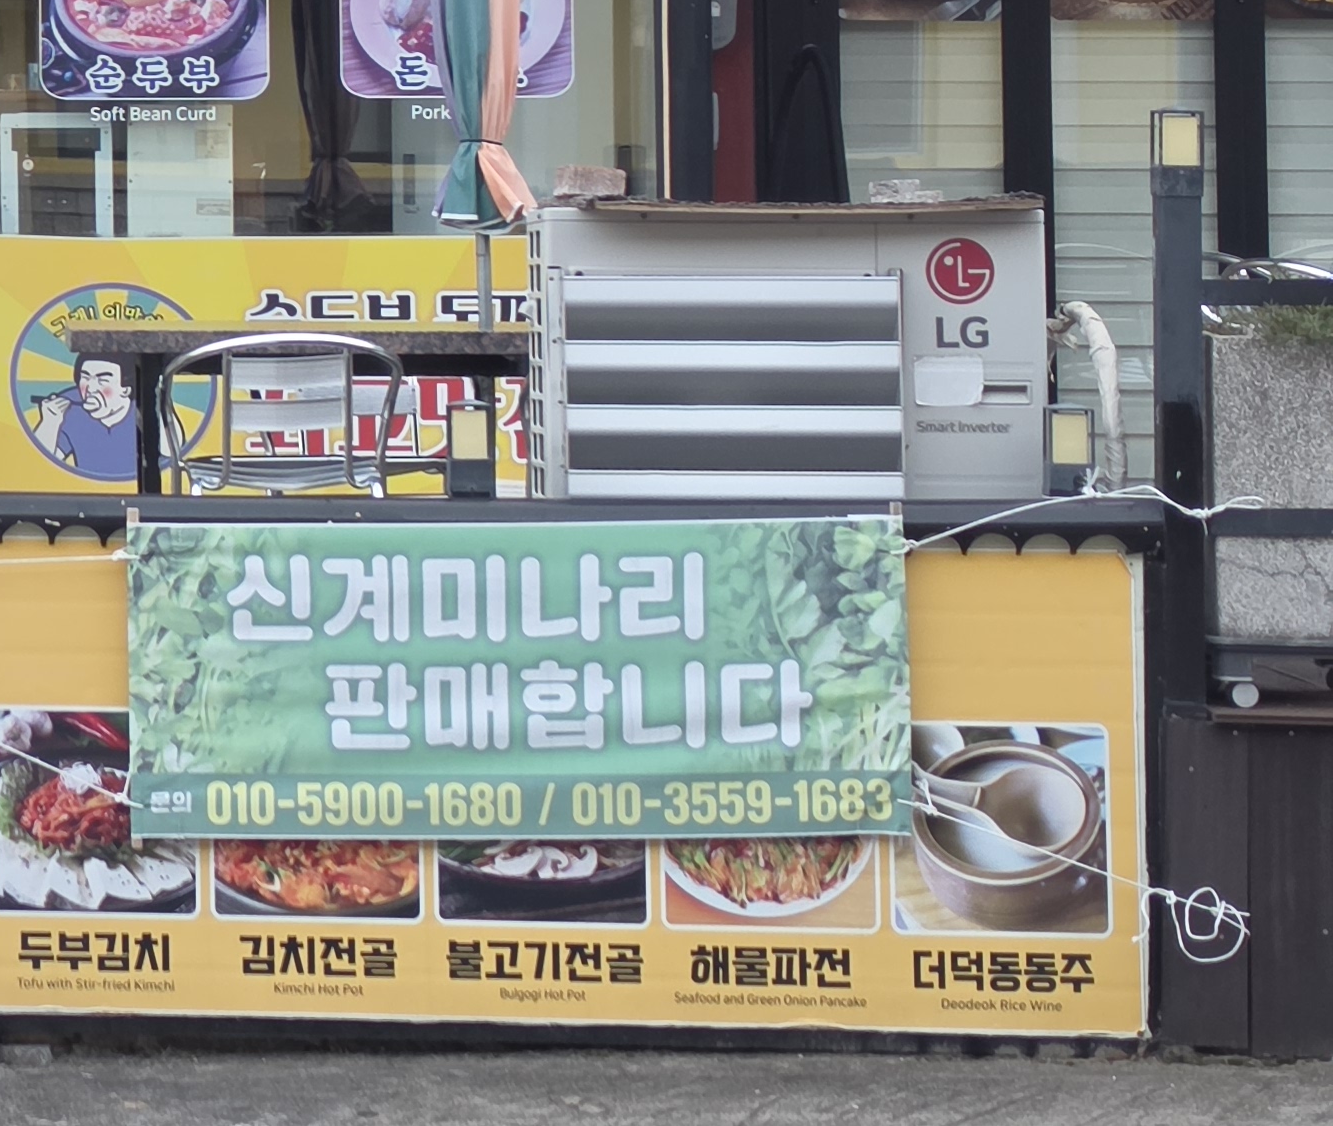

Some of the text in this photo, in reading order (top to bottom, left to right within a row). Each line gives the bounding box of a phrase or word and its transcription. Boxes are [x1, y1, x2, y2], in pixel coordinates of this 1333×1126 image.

[83, 54, 221, 95] 순두부
[87, 104, 218, 124] Soft Bean Curd
[410, 103, 452, 122] Pork
[935, 315, 990, 349] LG
[916, 420, 1011, 433] Smart Inverter
[225, 552, 706, 643] 신계미나리
[325, 659, 814, 751] 판매합니다
[149, 790, 194, 814] 문의
[207, 780, 523, 827] 010-5900-1680
[572, 778, 894, 826] 010-3559-1683
[18, 930, 171, 972] 두부김치
[239, 934, 398, 978] 김치전골
[445, 939, 644, 984] 불고기전골
[690, 944, 852, 989] 해물파전
[17, 976, 175, 992] Tofu with Stir-fried Kimchi
[273, 982, 364, 996] Kimchi Hot Pot
[912, 949, 1095, 994] 더덕동동주
[499, 986, 587, 1004] Bulgogi Hot Pot
[673, 990, 868, 1009] Seafood and Green Onion Pancake
[940, 996, 1063, 1013] Deodeok Rice Wine
